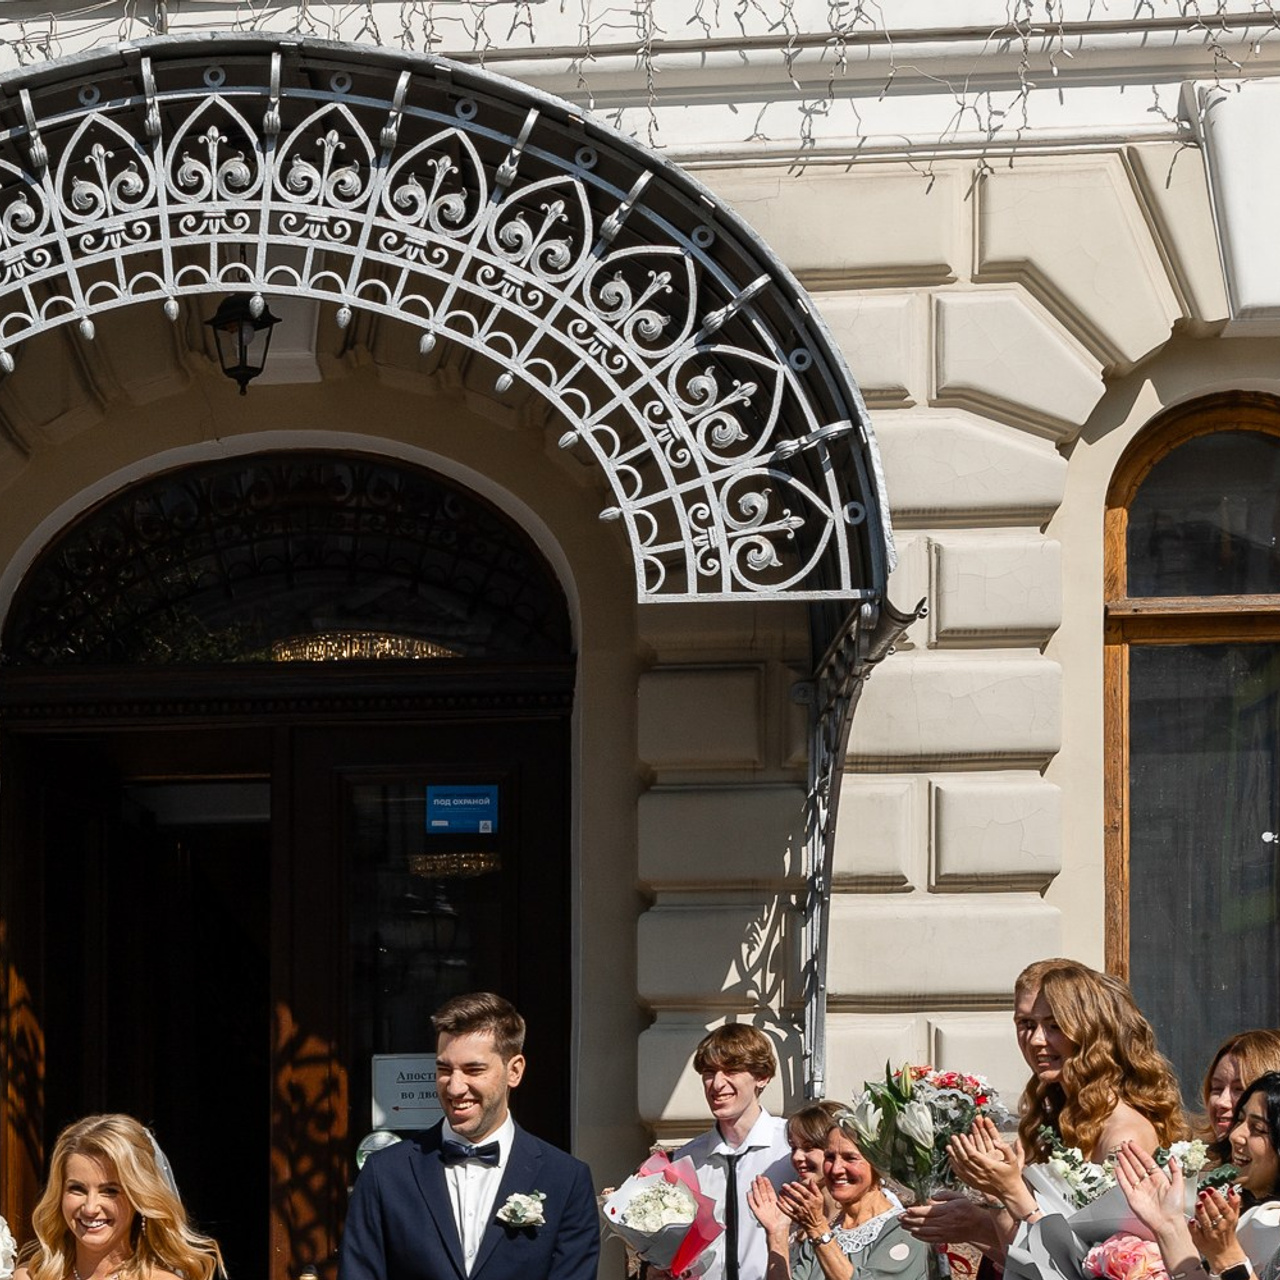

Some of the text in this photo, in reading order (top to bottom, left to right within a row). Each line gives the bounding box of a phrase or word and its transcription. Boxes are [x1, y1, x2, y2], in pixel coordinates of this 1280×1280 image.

[433, 797, 491, 807] ПОД ОХРАНОЙ
[396, 1071, 437, 1081] Апост
[418, 1091, 439, 1100] дво
